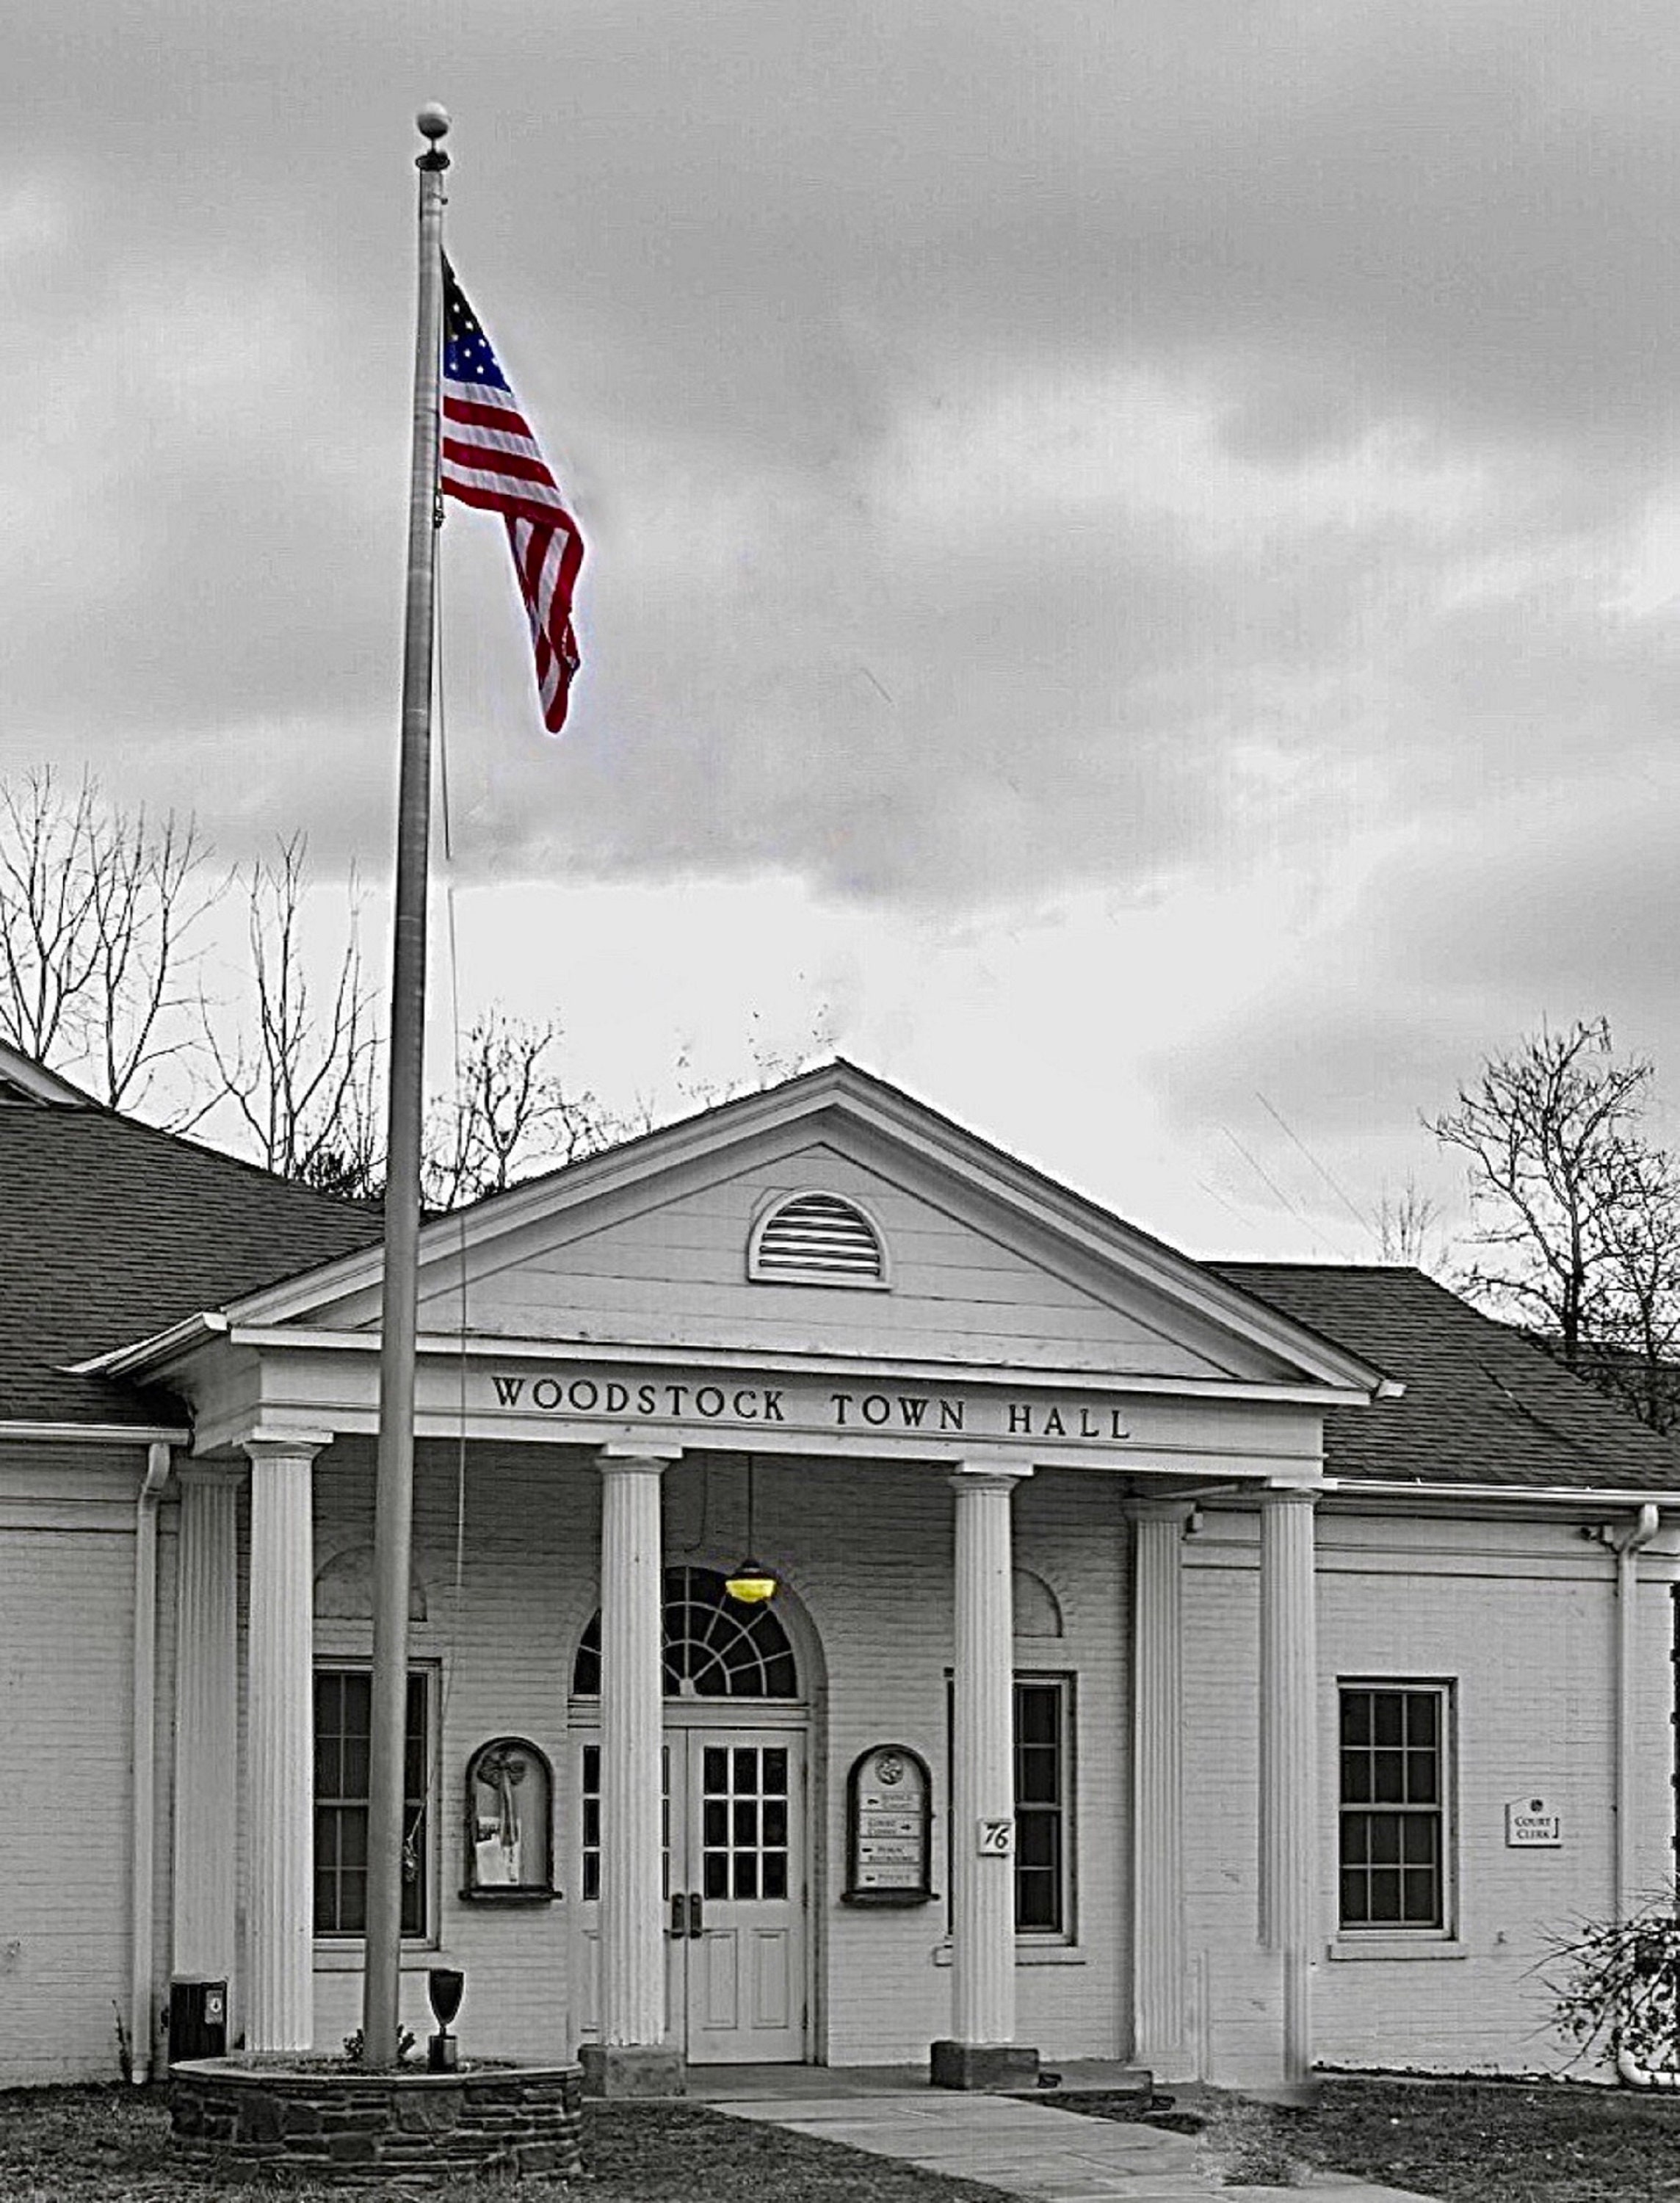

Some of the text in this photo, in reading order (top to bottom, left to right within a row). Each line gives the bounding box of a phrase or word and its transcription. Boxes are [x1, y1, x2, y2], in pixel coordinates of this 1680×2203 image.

[492, 1376, 1131, 1439] WOODSTOCK TOWN HALL
[985, 1823, 1010, 1849] 76
